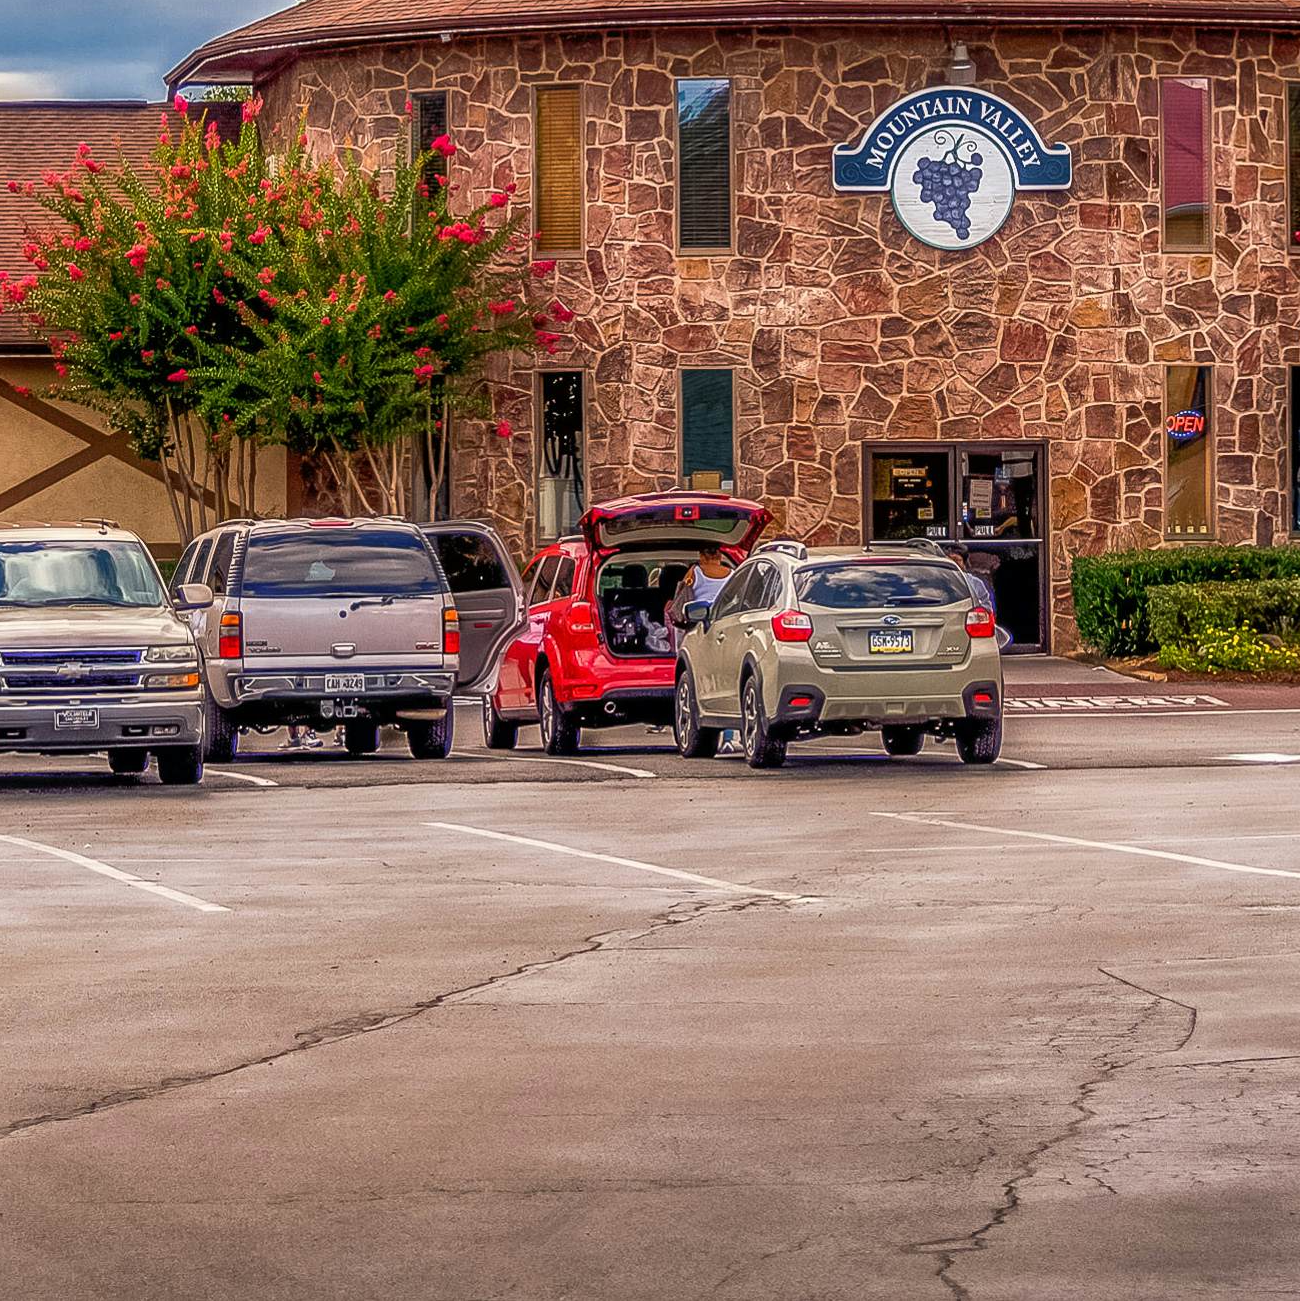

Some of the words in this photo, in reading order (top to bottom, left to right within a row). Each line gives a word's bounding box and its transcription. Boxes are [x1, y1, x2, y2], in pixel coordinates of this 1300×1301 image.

[866, 96, 972, 169] MOUNTAIN
[980, 100, 1041, 169] VALLEY
[1166, 415, 1204, 432] OPEN
[926, 526, 946, 537] PULL
[975, 525, 994, 536] PULL
[415, 641, 440, 650] GMC
